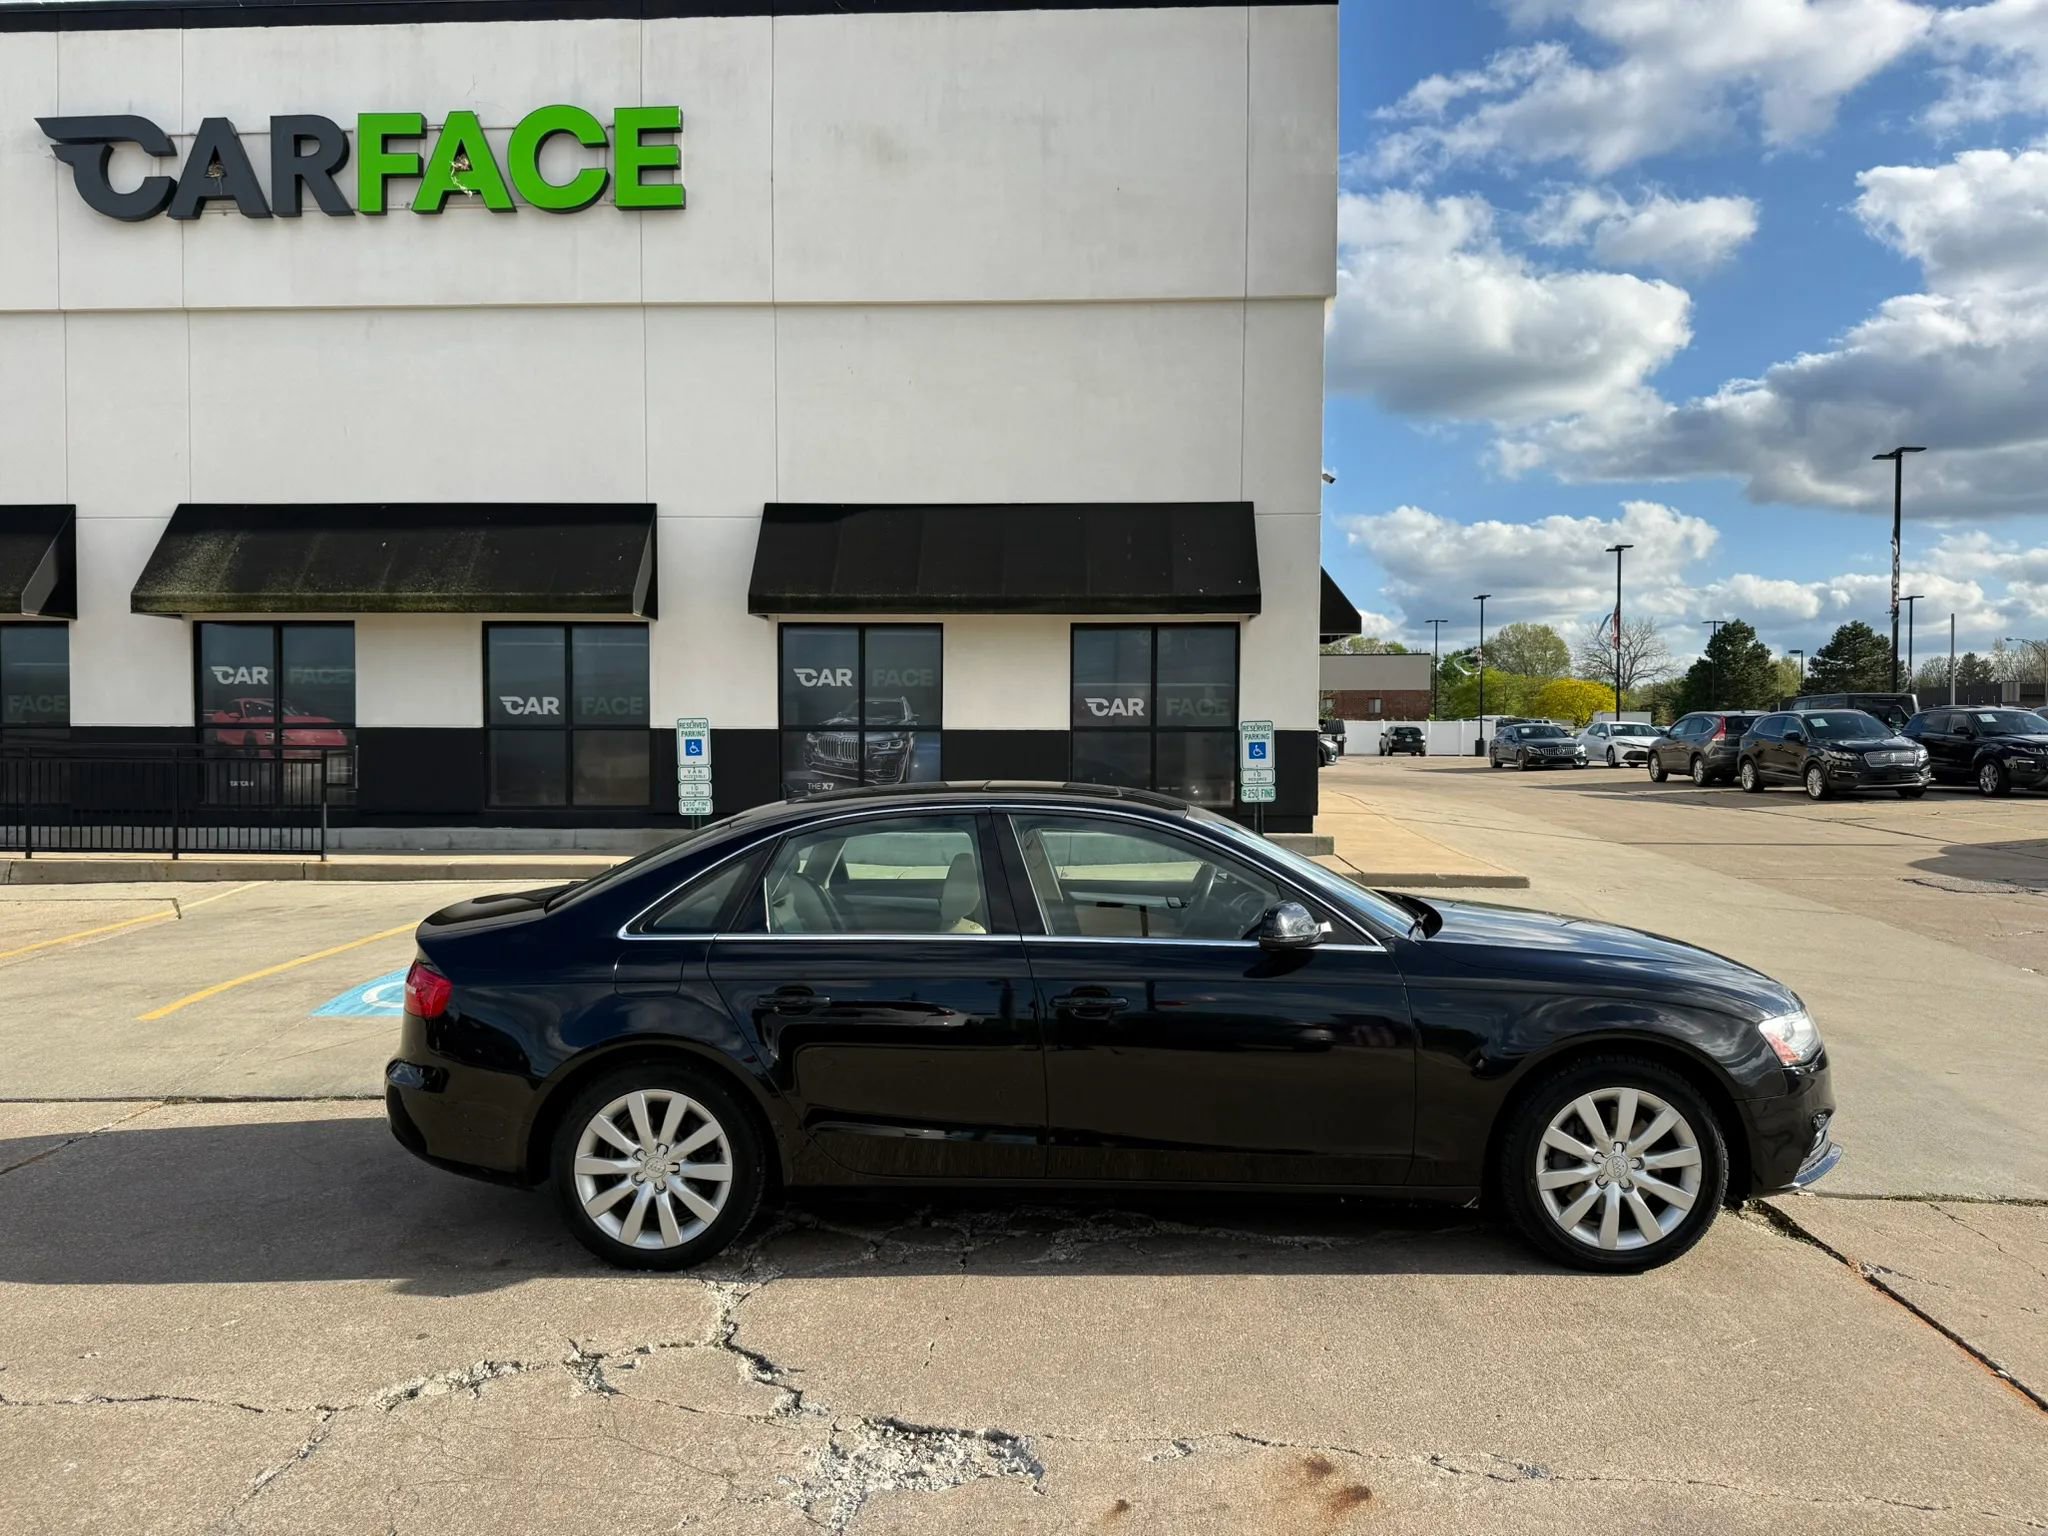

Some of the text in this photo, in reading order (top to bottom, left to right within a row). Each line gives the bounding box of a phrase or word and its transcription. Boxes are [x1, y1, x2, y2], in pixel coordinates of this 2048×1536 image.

[210, 665, 269, 685] CAR
[793, 668, 934, 687] CAR FACE
[8, 695, 66, 713] FACE
[500, 696, 644, 715] CAR FACE
[1085, 697, 1228, 716] CAR FACE
[1242, 724, 1271, 732] RESERVED
[807, 782, 835, 790] THE X7
[1261, 788, 1274, 798] FINE
